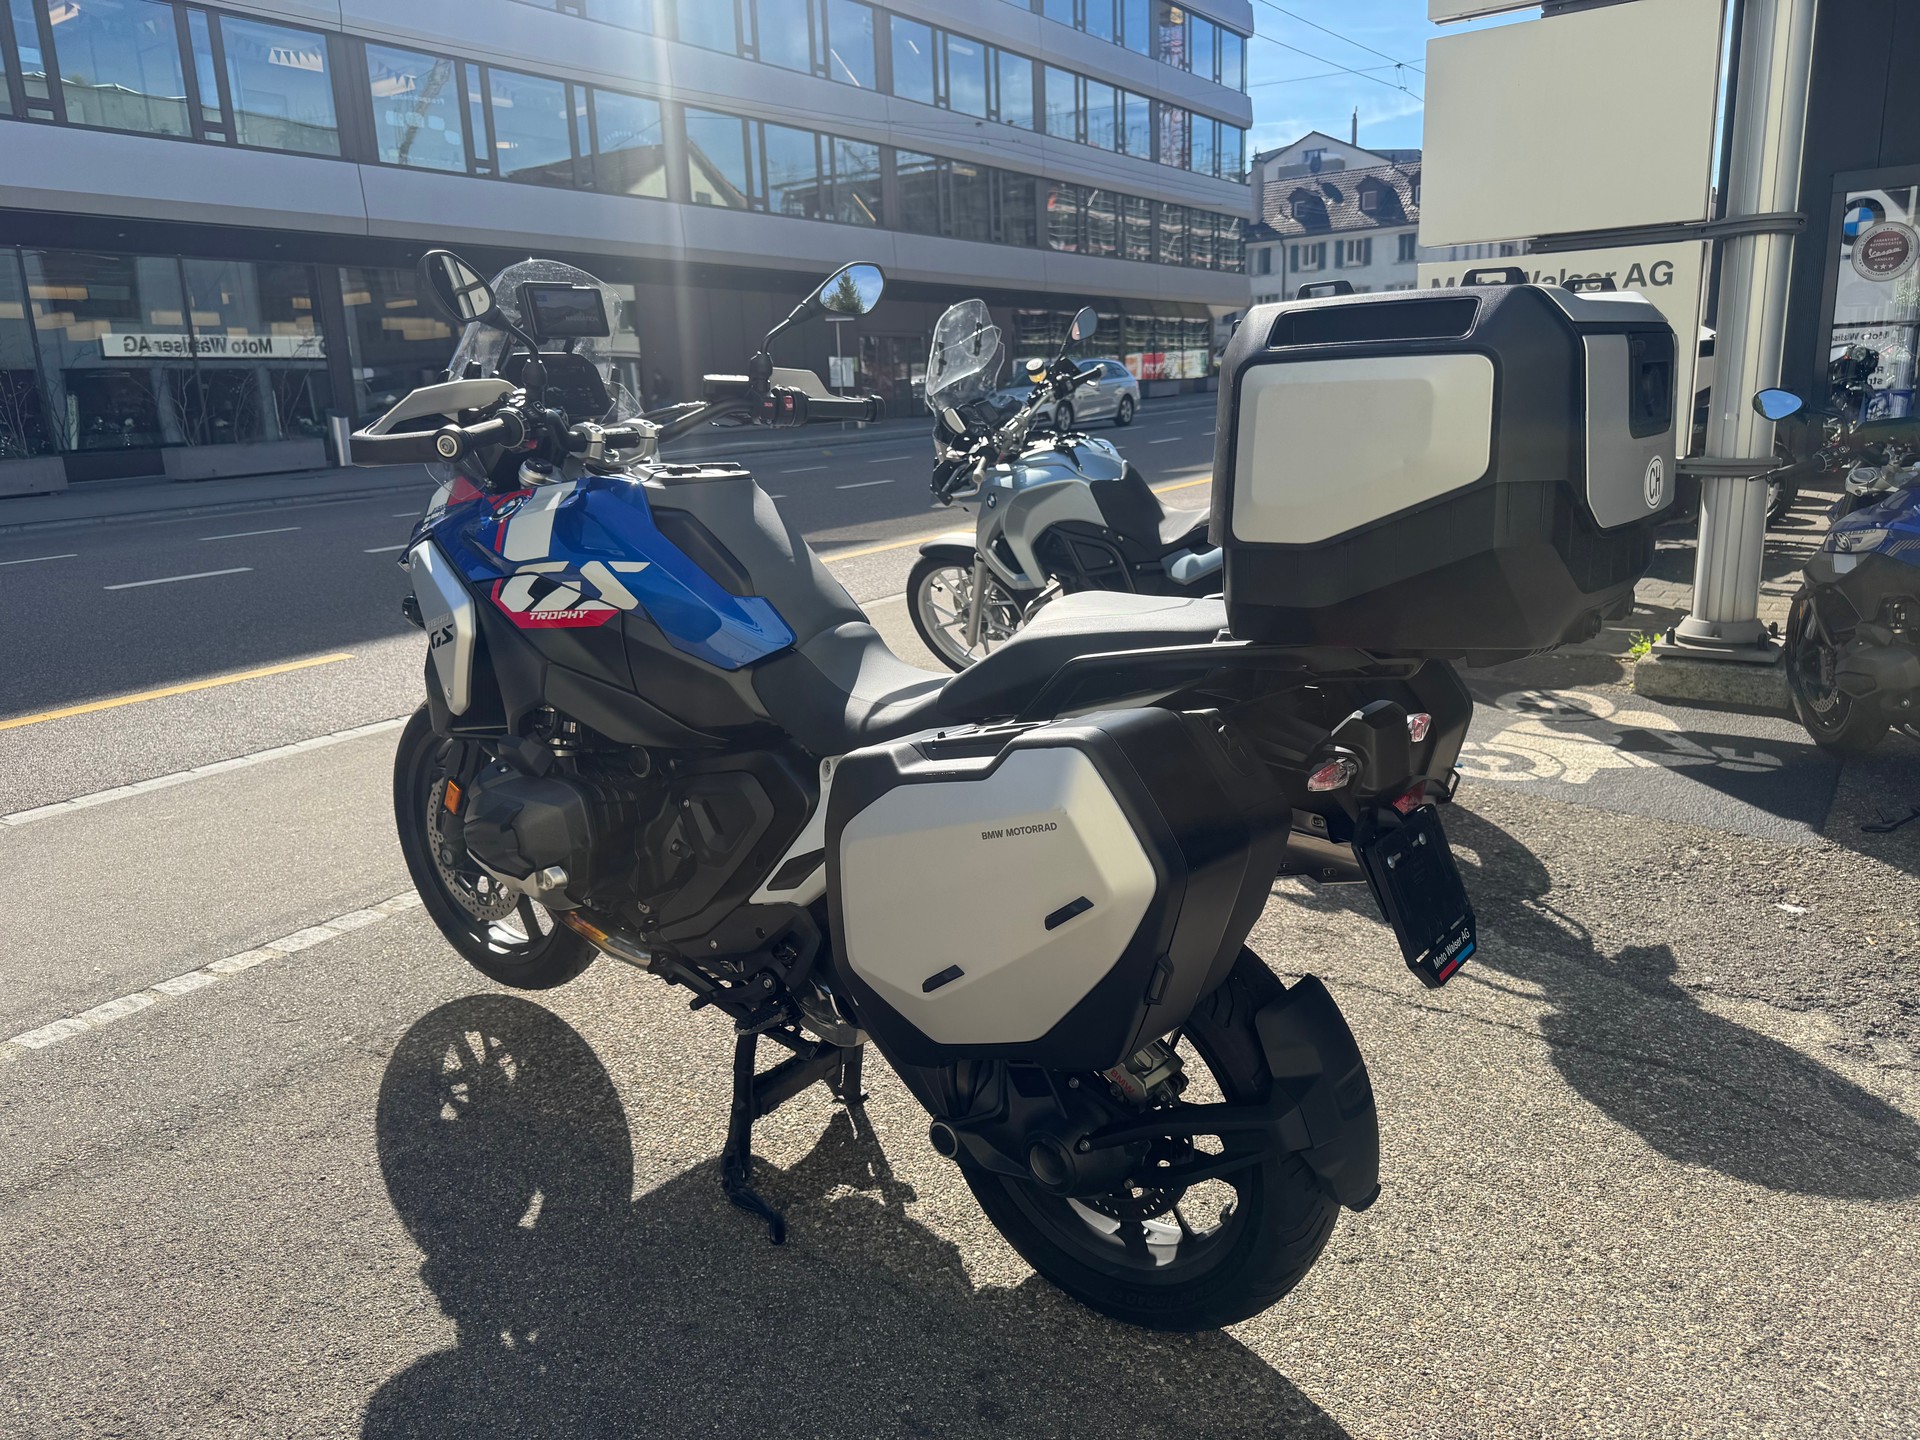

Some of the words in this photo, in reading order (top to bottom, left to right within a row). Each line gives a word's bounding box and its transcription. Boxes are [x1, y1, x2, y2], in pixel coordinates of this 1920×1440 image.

[1622, 260, 1674, 288] AG
[1650, 464, 1660, 499] CH
[500, 560, 650, 613] GS
[529, 610, 588, 620] TROPHY
[431, 623, 454, 650] GS
[981, 829, 1003, 840] BMW
[1005, 822, 1057, 837] MOTORRAD
[1432, 952, 1448, 969] Moto
[1444, 936, 1462, 956] Walser
[1460, 927, 1470, 942] AG
[1110, 1069, 1136, 1093] BMW
